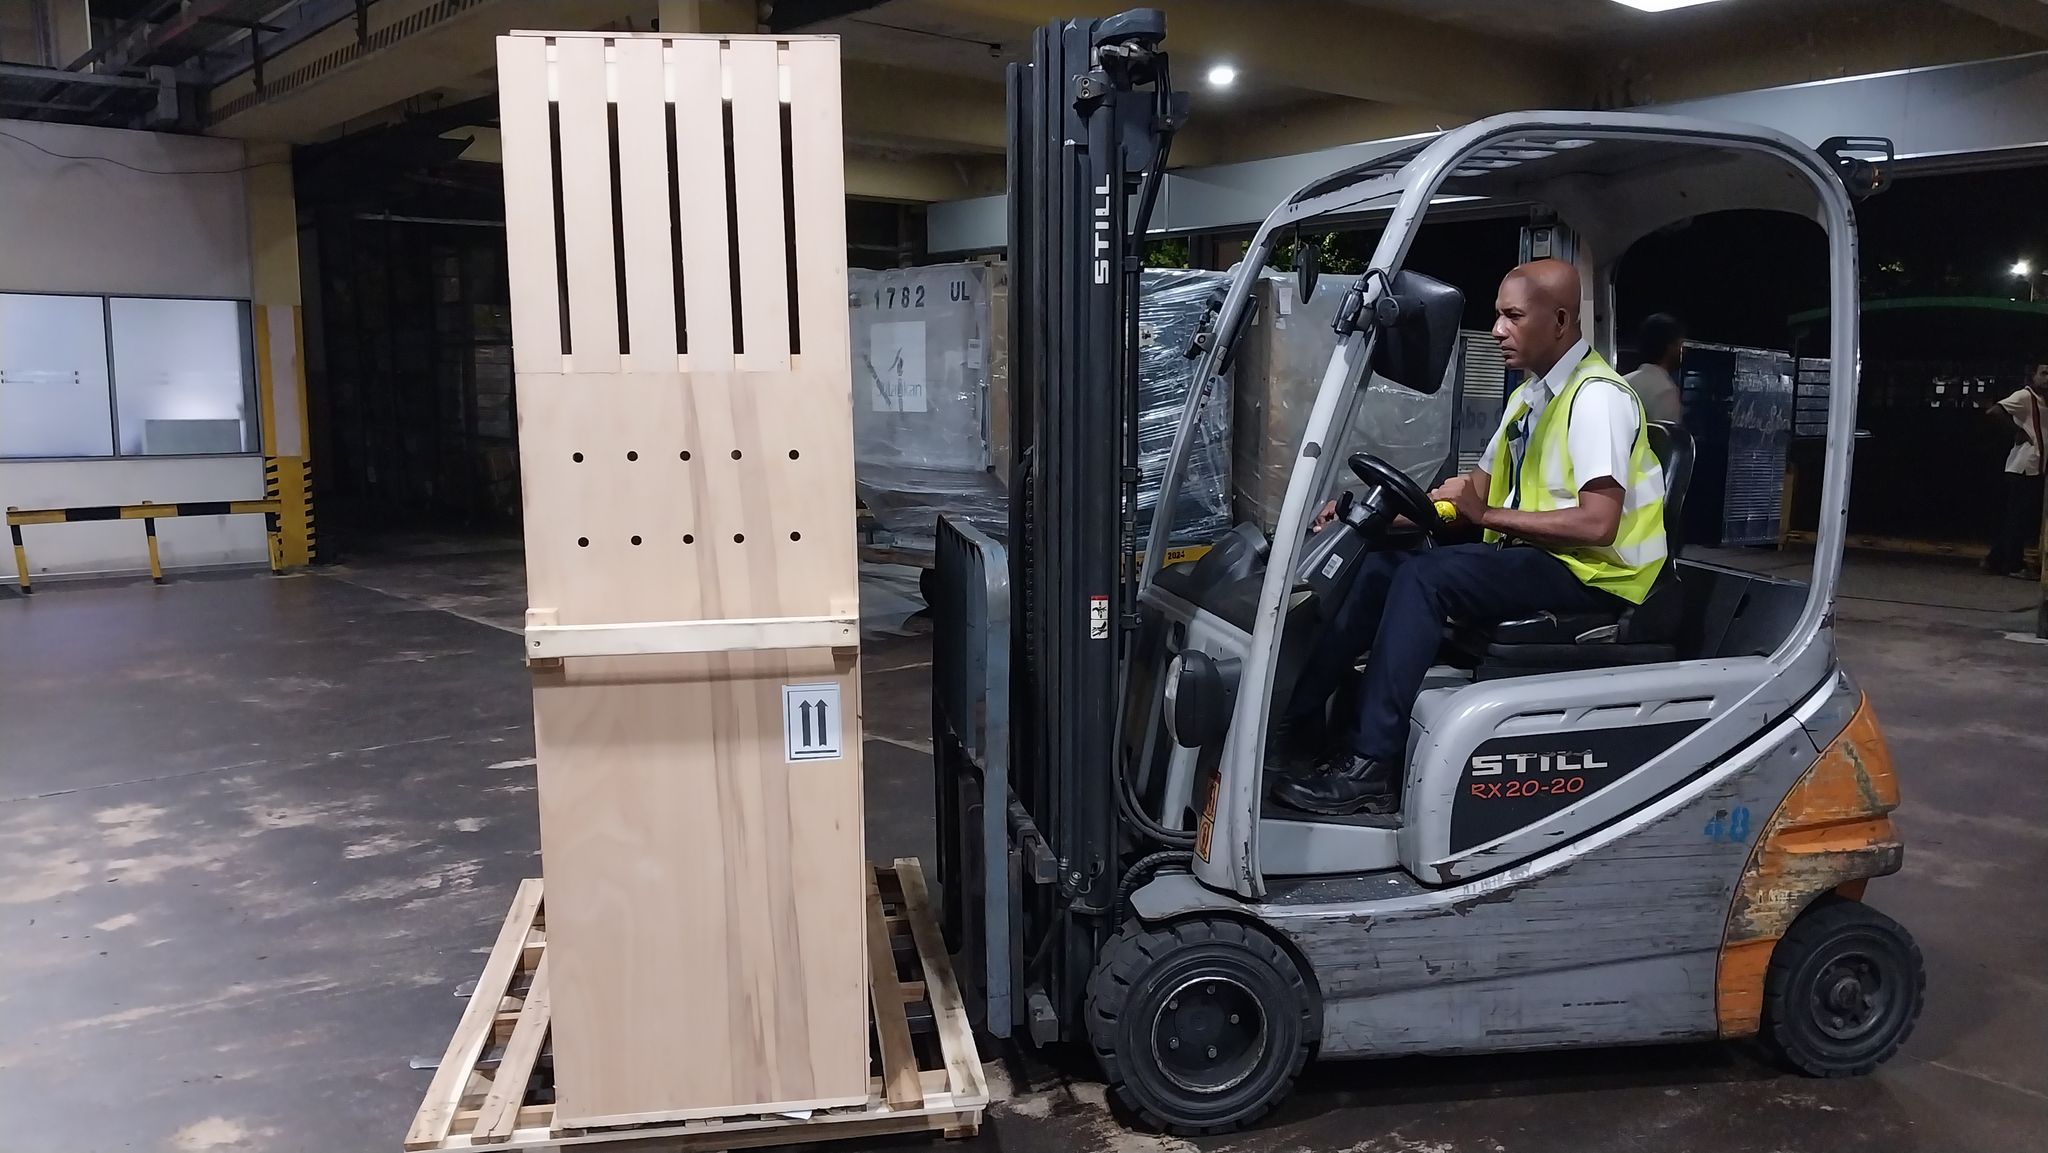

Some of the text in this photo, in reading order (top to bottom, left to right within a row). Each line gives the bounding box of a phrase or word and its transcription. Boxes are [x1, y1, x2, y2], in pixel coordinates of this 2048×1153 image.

[1094, 173, 1111, 284] STILL
[874, 285, 925, 310] 1782
[950, 281, 970, 301] UL
[1471, 751, 1609, 777] STILL
[1703, 806, 1751, 843] 48
